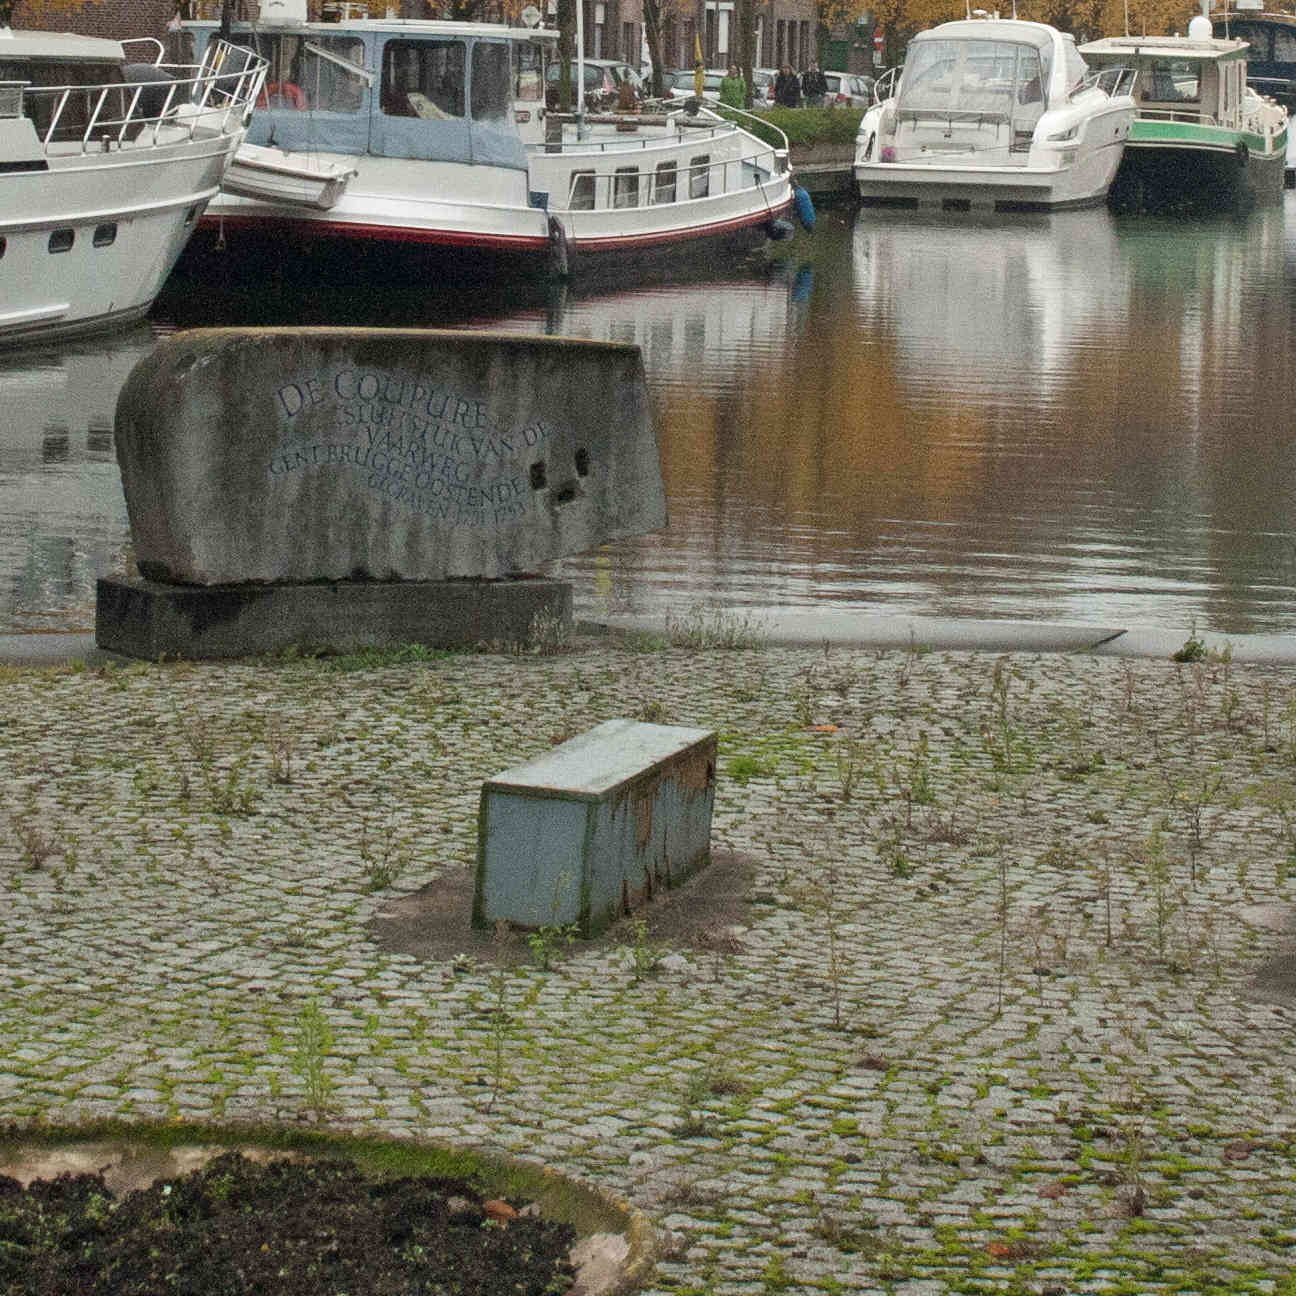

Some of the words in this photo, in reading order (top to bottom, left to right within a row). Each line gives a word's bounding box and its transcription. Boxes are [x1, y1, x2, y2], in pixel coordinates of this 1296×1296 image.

[278, 378, 326, 418] DE
[335, 369, 489, 429] COUPURE
[470, 435, 516, 460] VAN
